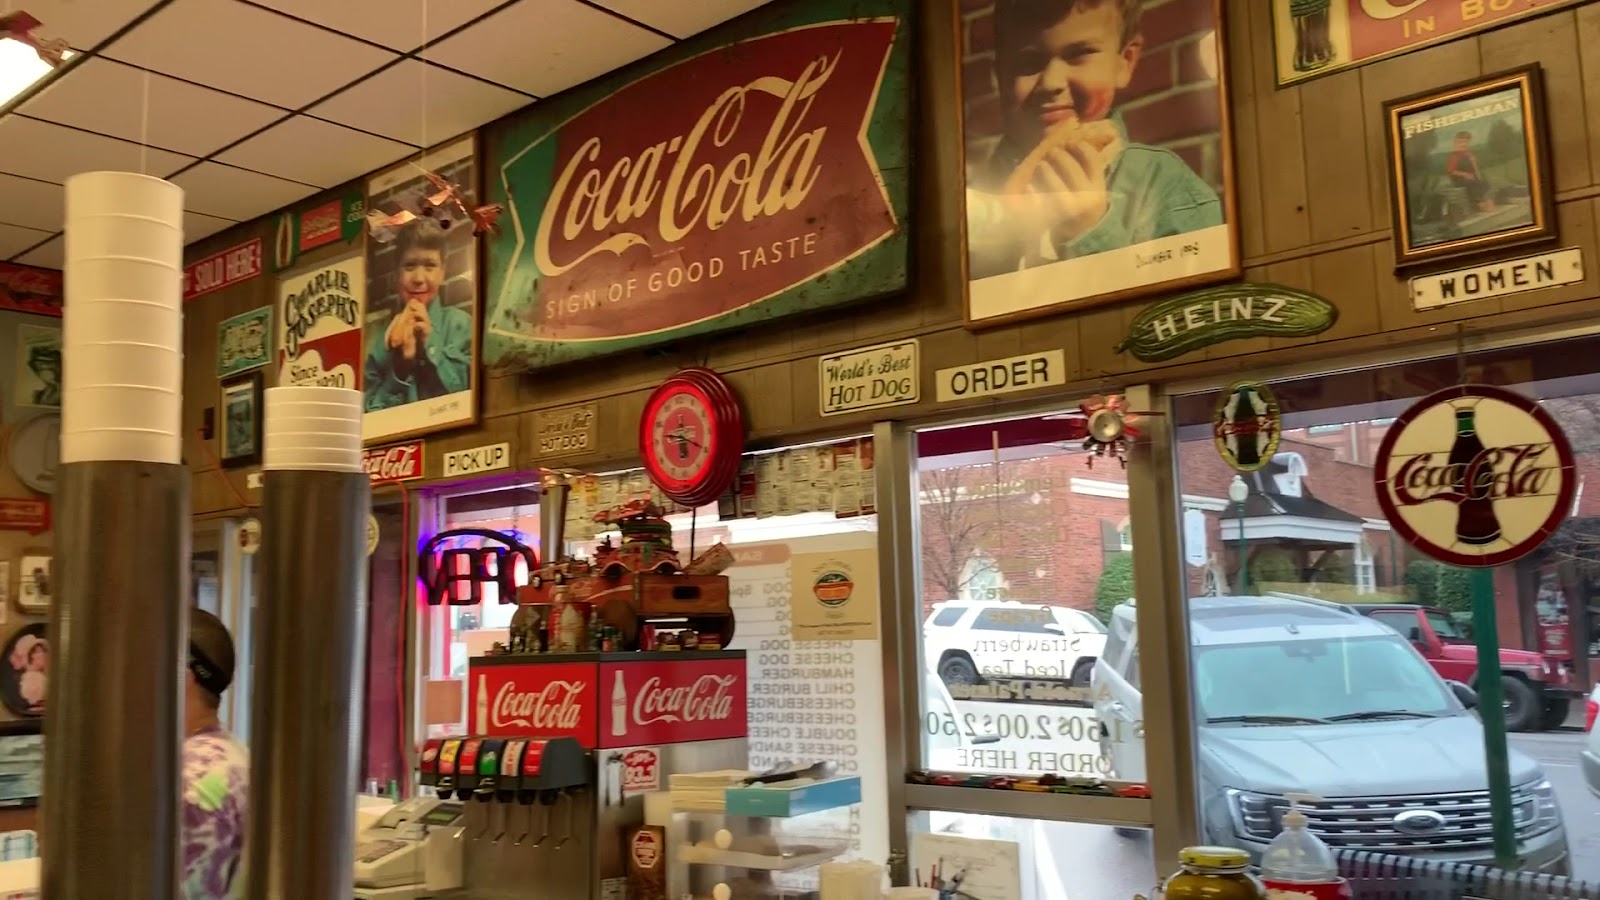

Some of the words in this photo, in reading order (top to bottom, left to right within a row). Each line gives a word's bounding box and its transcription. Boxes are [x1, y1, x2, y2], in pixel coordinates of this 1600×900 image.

[1403, 15, 1436, 38] IN
[1403, 97, 1520, 139] FISHERMAN
[534, 47, 842, 277] Coca-Cola
[195, 257, 223, 291] SOLD
[226, 245, 256, 281] HERE
[546, 288, 597, 320] SIGN
[609, 279, 638, 303] OF
[648, 257, 724, 293] GOOD
[739, 232, 818, 272] TASTE
[1440, 260, 1555, 299] WOMEN
[1153, 296, 1287, 341] HEINZ
[290, 365, 319, 384] Since
[827, 359, 874, 383] World's
[878, 353, 911, 373] Best
[951, 357, 1049, 395] ORDER
[829, 384, 865, 406] HOT
[872, 377, 911, 399] DOG
[449, 452, 481, 471] PICK
[484, 447, 503, 467] UP
[492, 680, 587, 729] Coca-Cola
[632, 674, 738, 725] Coca-Cola
